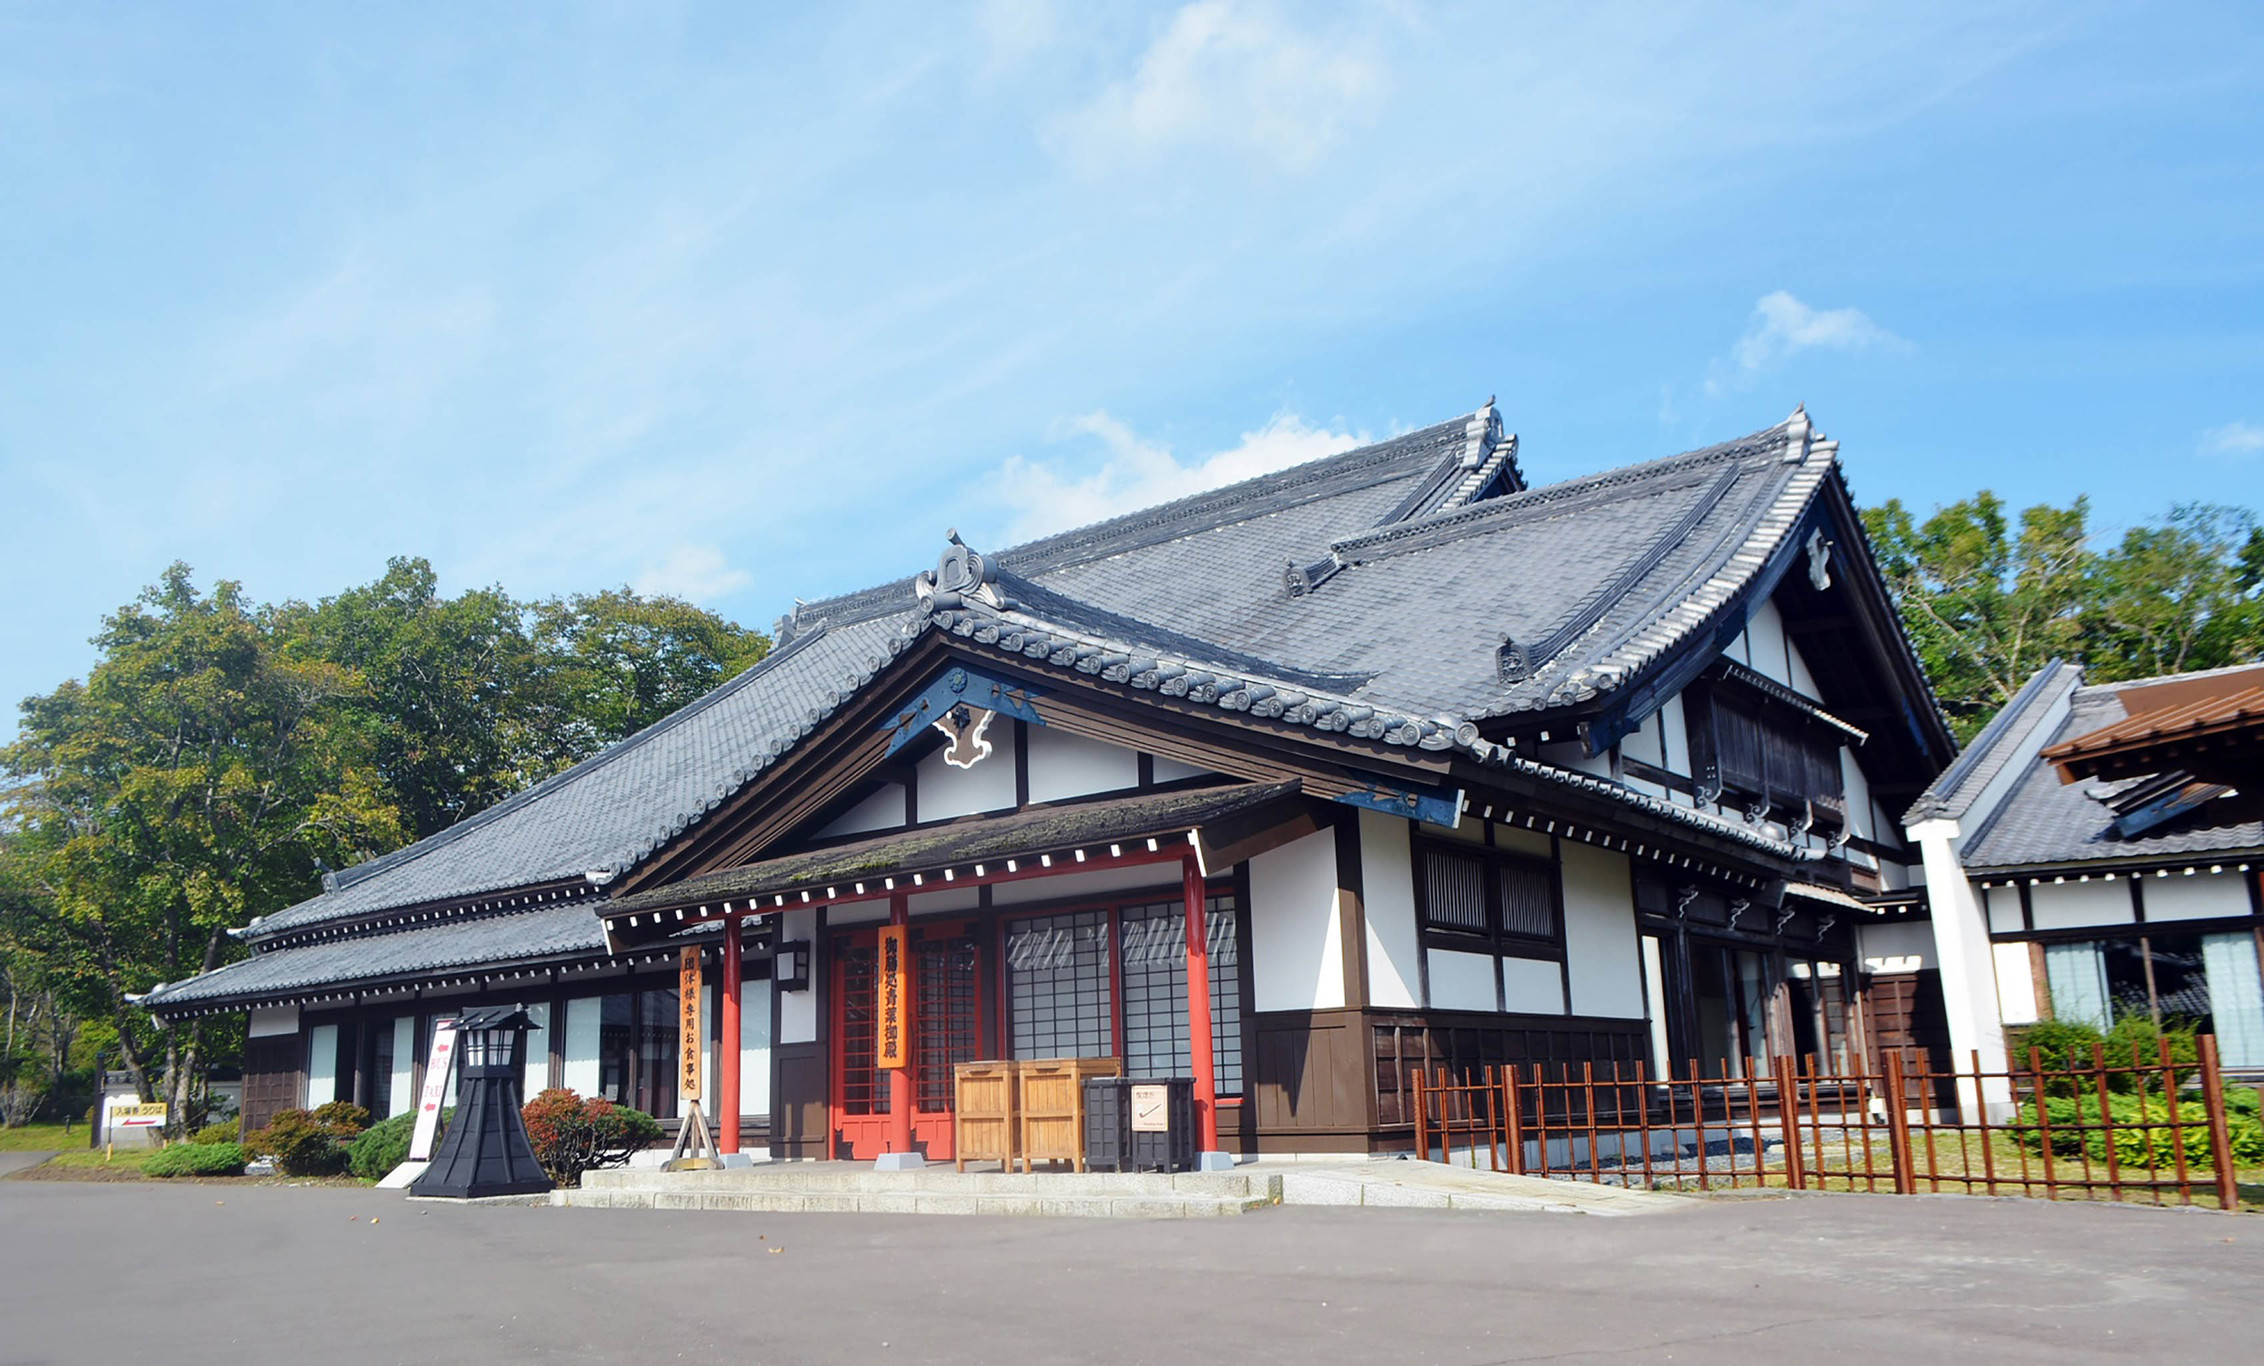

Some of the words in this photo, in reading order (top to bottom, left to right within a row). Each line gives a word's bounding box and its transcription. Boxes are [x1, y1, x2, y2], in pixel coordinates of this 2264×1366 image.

[684, 957, 696, 1091] 団体様専用お食事処
[430, 1057, 448, 1070] BUS
